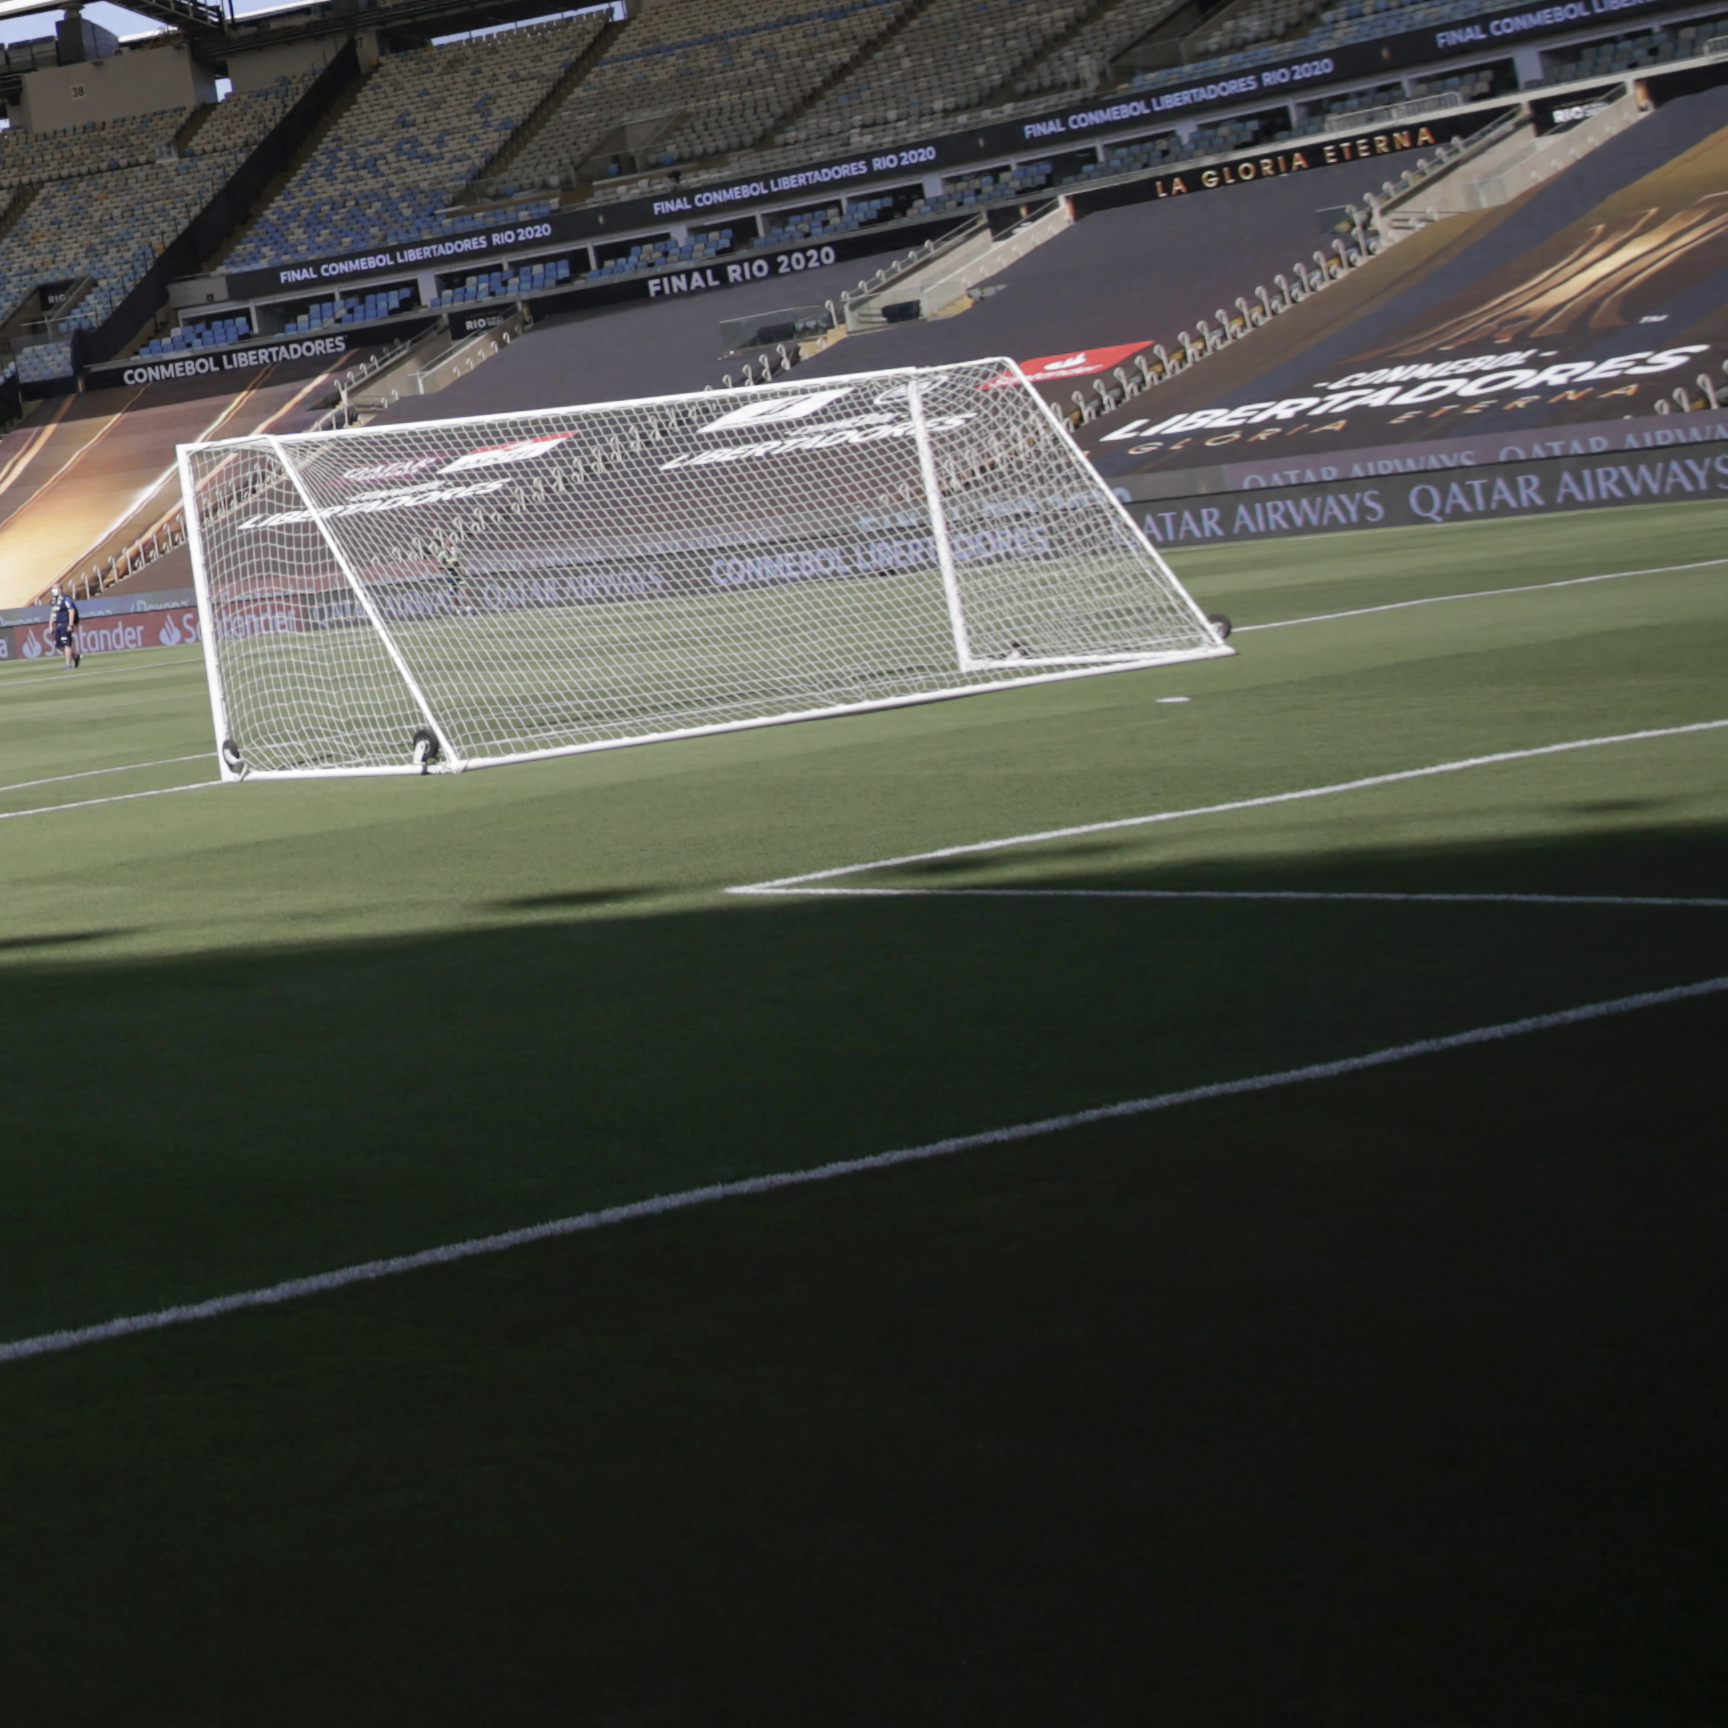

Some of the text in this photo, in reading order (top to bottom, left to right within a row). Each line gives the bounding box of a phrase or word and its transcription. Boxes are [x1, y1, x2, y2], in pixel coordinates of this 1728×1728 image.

[1436, 24, 1486, 48] FINAL
[1489, 1, 1590, 36] CONMEBOL
[1024, 58, 1334, 139] FINAL CONMEBOL LIBERTADORES RIO 2020
[653, 146, 936, 215] FINAL CONMEBOL LIBERTADORES RIO 2020
[1155, 127, 1437, 198] LA GLORIA ETERNA
[280, 223, 552, 284] FINAL CONMEBOL LIBERTADORES RIO 2020
[648, 246, 836, 298] FINAL RIO 2020
[465, 318, 486, 331] RIO
[123, 336, 347, 385] CONMEBOL LIBERTADORES
[1099, 343, 1711, 443] LIBERTADORES
[1388, 383, 1641, 425] ETERNA
[1138, 508, 1265, 542] ATAR
[1233, 488, 1385, 534] AIRWAYS
[1408, 472, 1547, 523] QATAR
